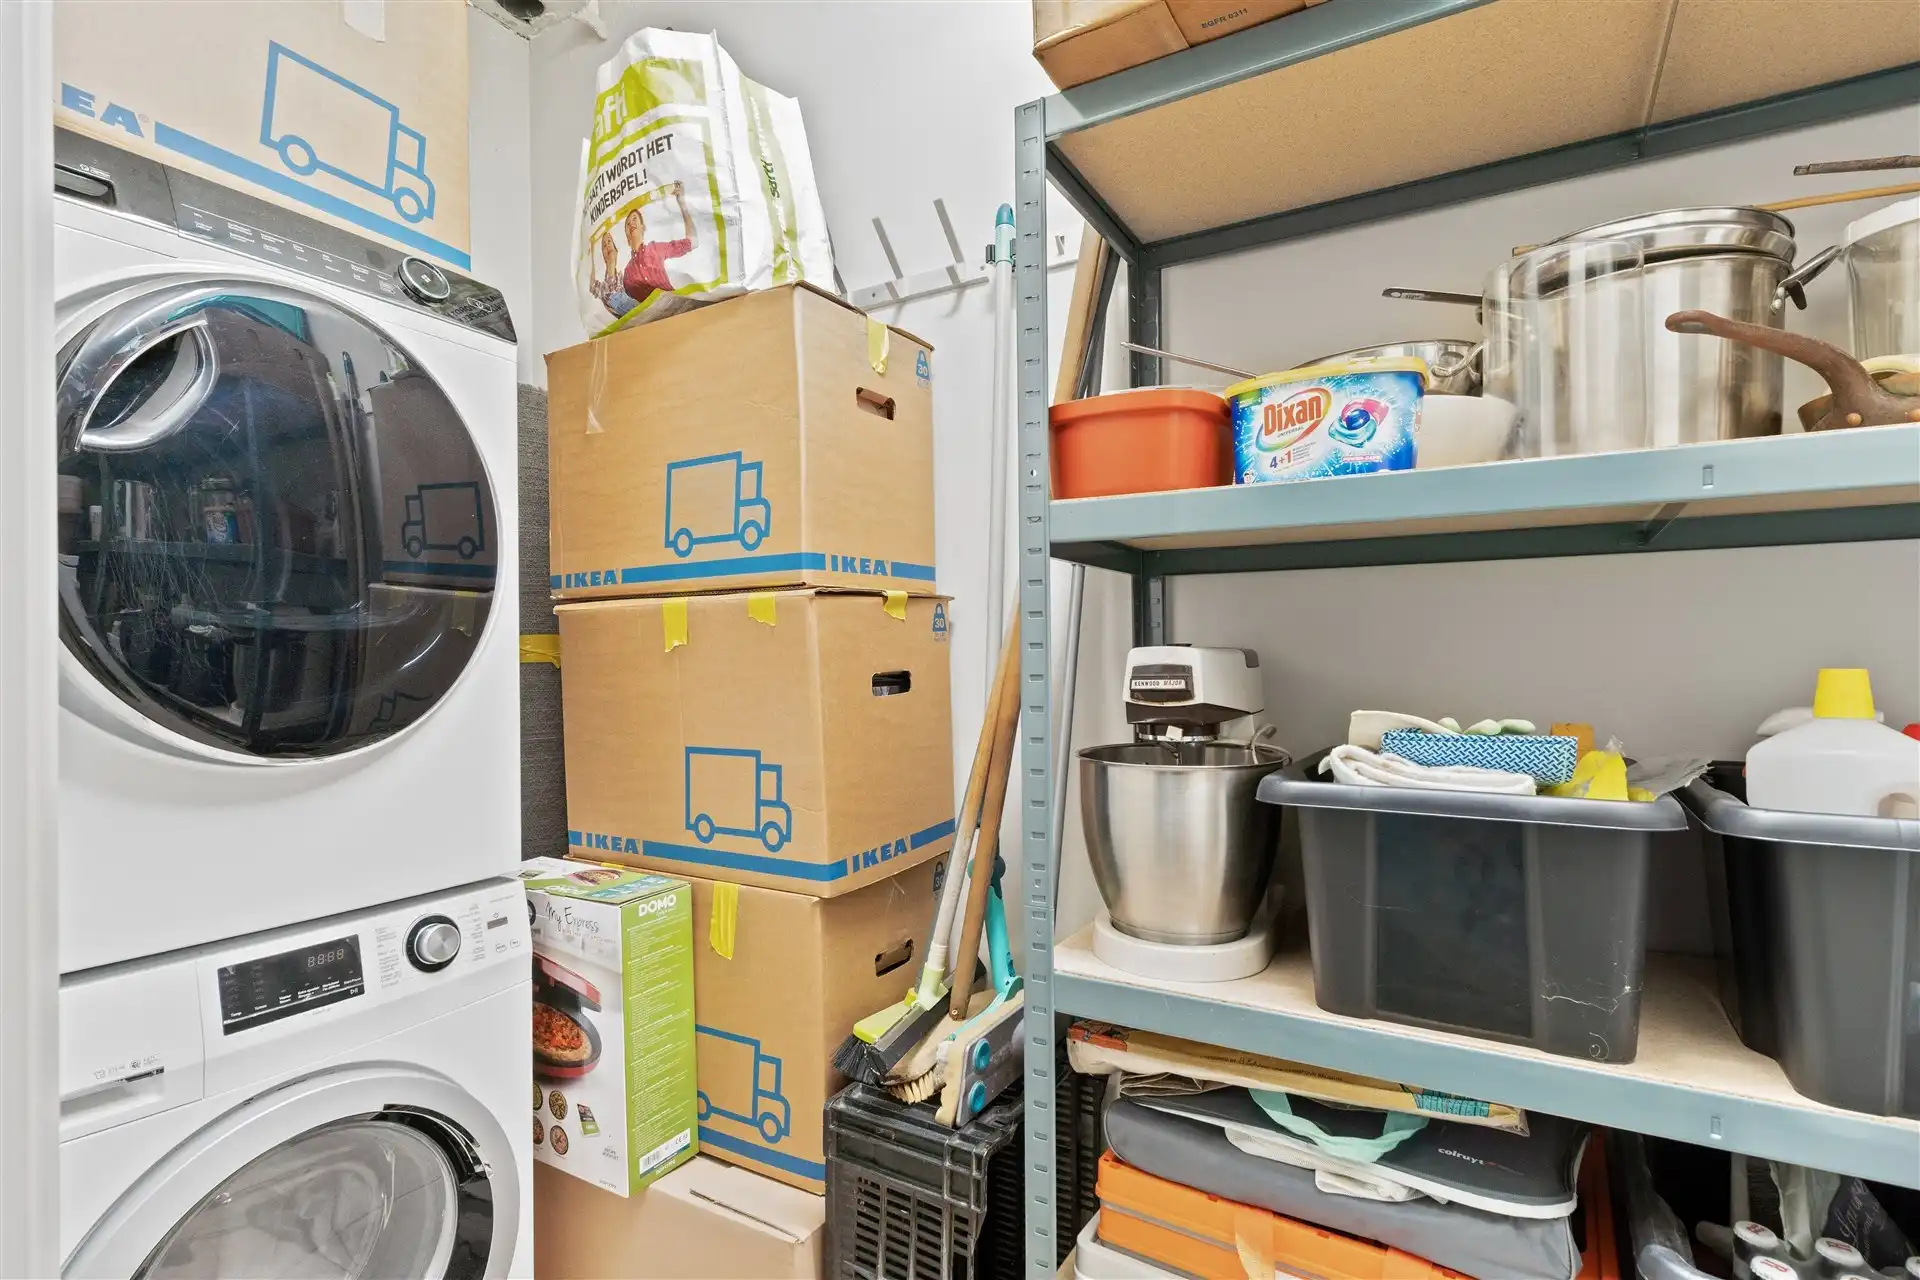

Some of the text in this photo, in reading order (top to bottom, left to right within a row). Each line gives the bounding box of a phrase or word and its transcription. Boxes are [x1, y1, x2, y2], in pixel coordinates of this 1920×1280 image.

[61, 82, 144, 138] EA
[595, 82, 628, 141] afti
[606, 147, 644, 183] WORDT
[646, 133, 673, 159] HET
[590, 168, 647, 226] KINDERSPEL!
[1264, 395, 1322, 437] Dixan
[565, 569, 618, 588] IKEA
[831, 554, 888, 576] IKEA
[934, 617, 945, 629] 30
[586, 832, 639, 854] IKEA
[852, 837, 908, 873] IKEA
[545, 901, 601, 933] My Express
[638, 894, 677, 917] DOMO
[1438, 1147, 1484, 1165] colruyt
